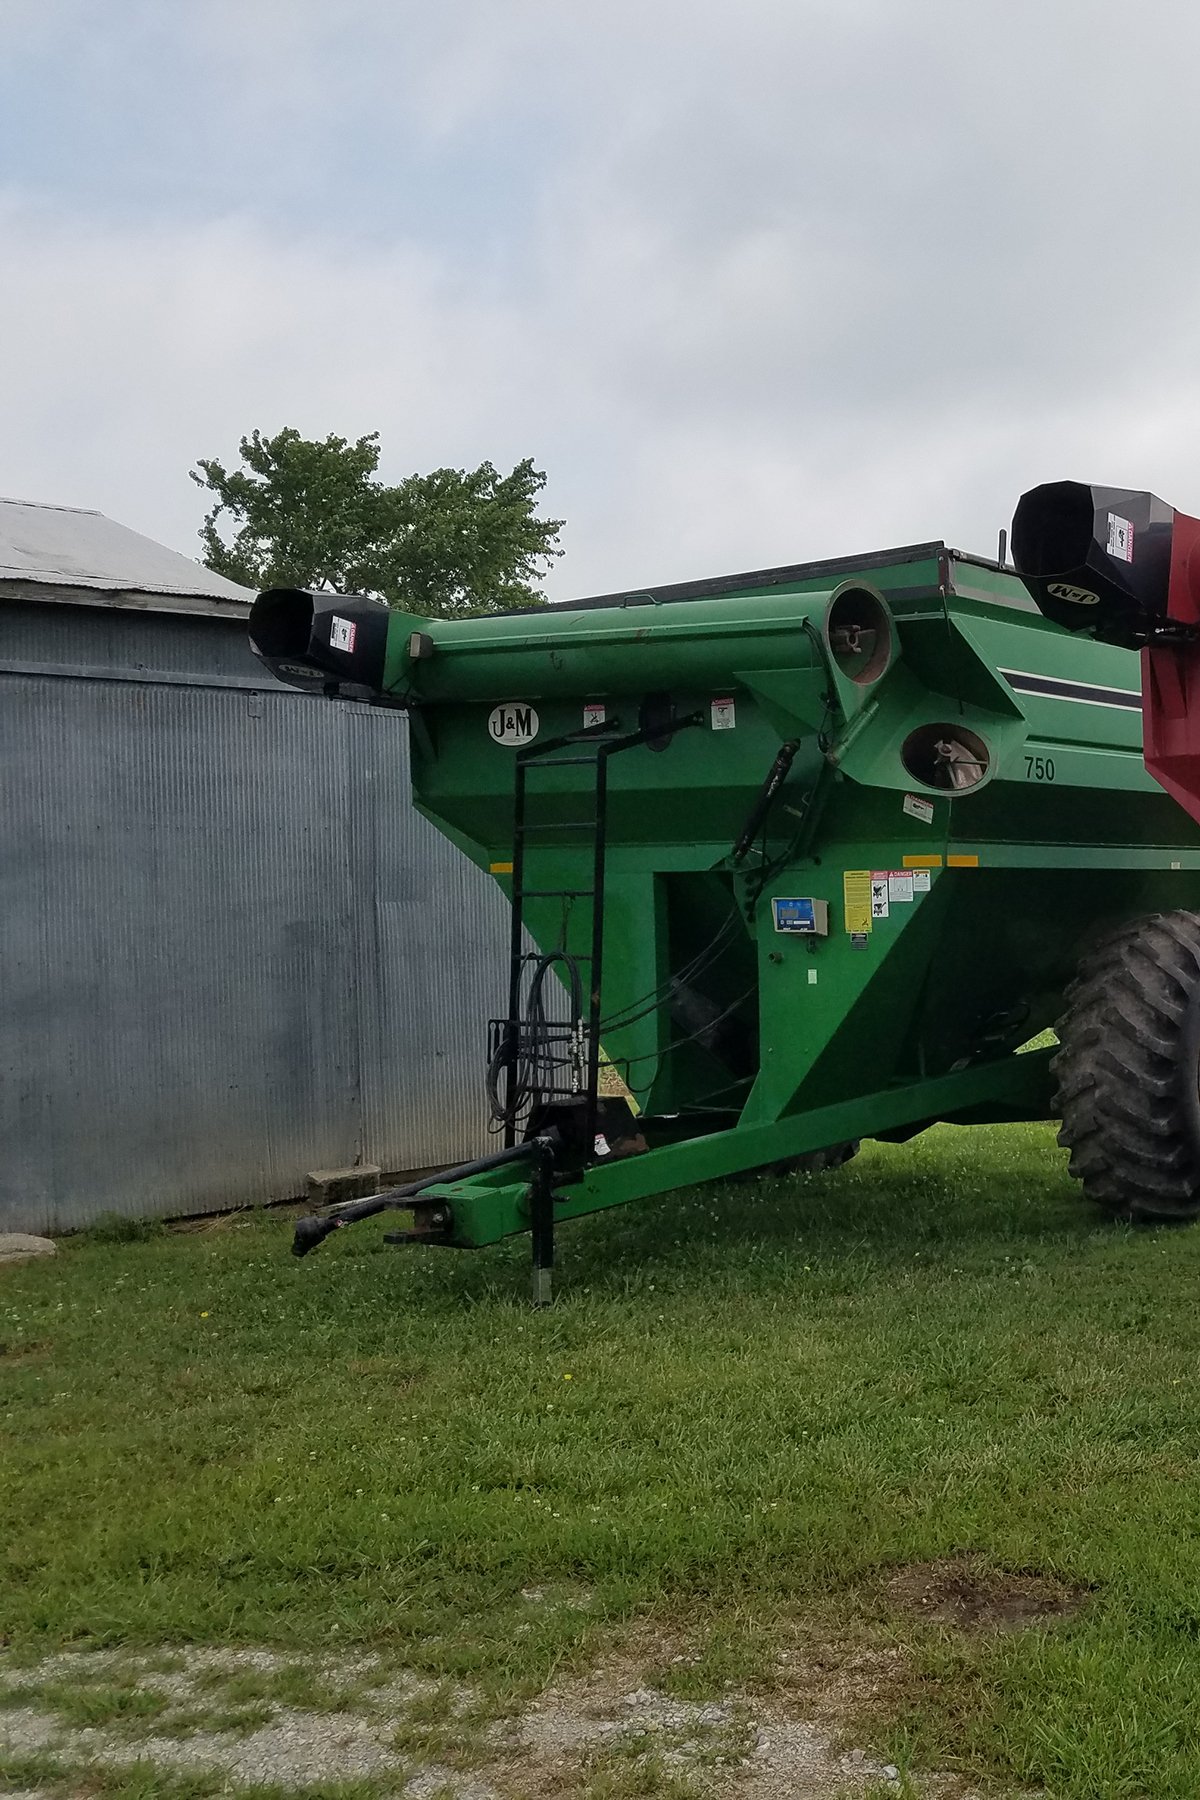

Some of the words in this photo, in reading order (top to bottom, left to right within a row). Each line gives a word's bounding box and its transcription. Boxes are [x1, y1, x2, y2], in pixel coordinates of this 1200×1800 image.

[1051, 585, 1096, 602] J&M
[492, 708, 533, 738] J&M
[1024, 756, 1055, 781] 750
